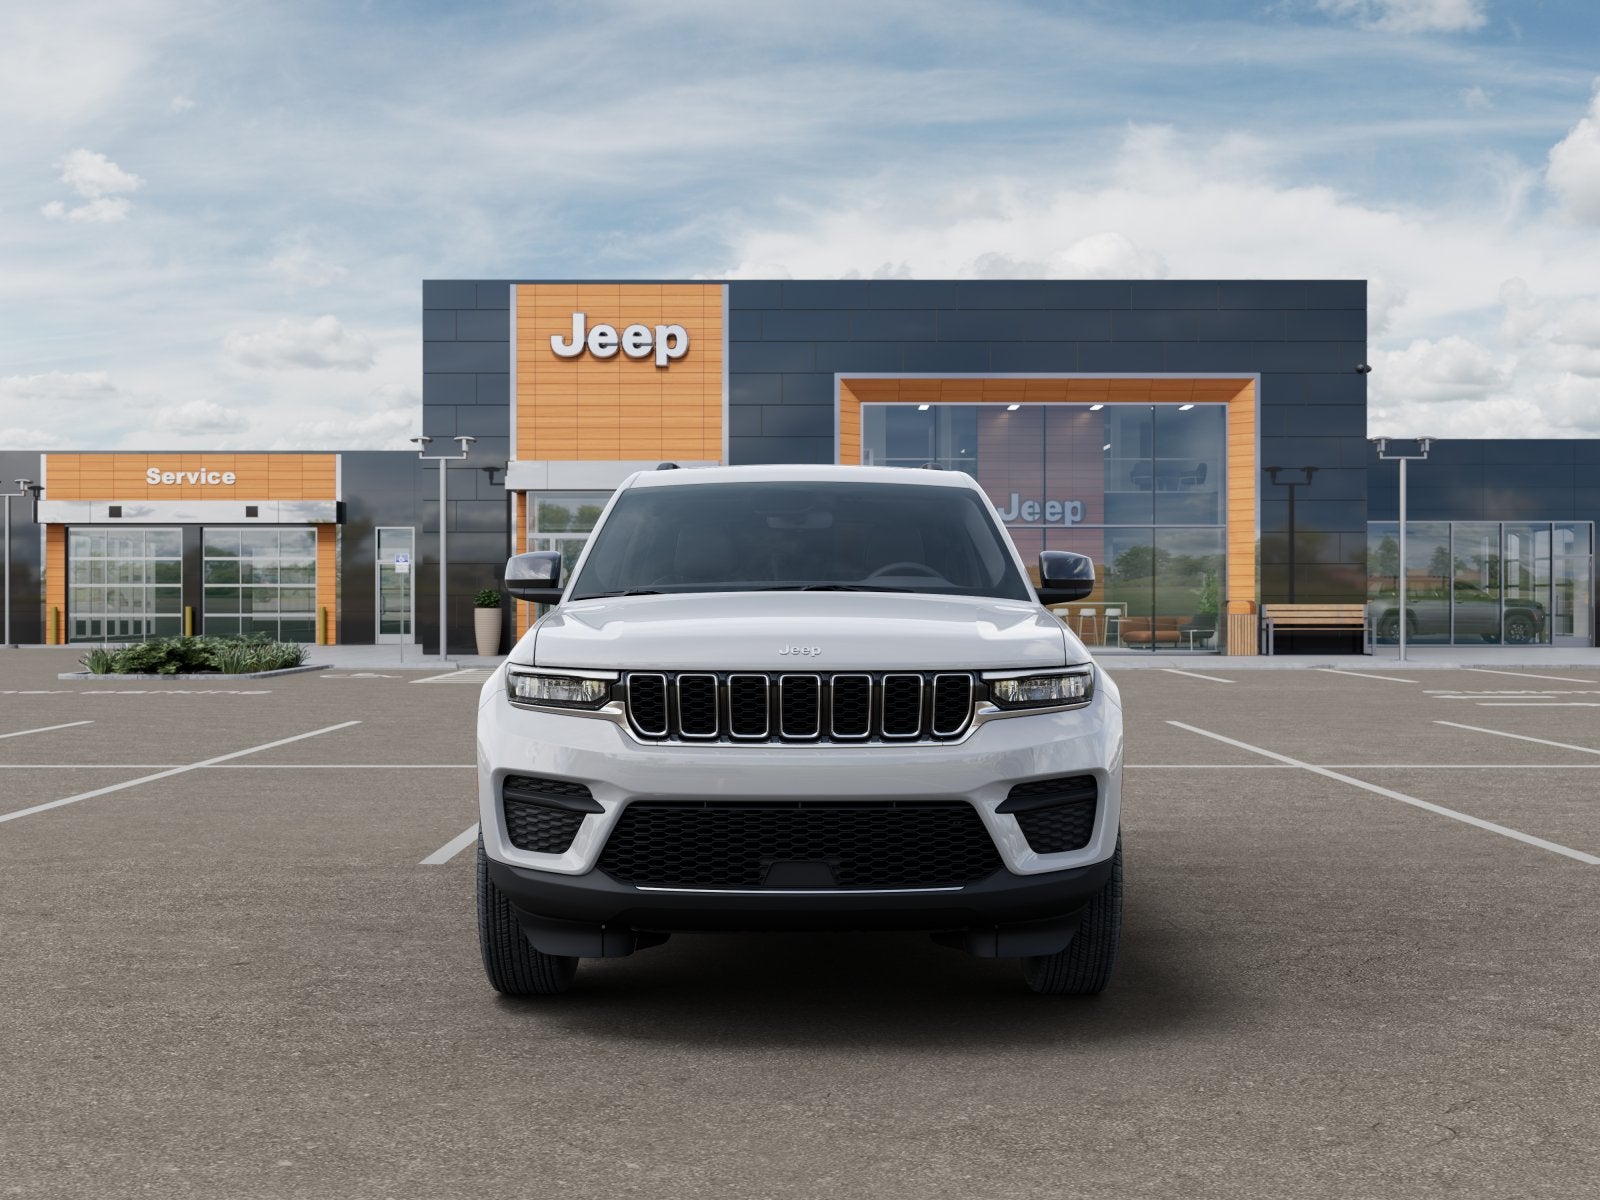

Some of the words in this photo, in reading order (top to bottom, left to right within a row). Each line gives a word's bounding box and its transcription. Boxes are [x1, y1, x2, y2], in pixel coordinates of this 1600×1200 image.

[550, 312, 689, 367] Jeep
[146, 467, 237, 485] Service
[997, 493, 1084, 526] Jeep
[778, 642, 822, 657] Jeep
